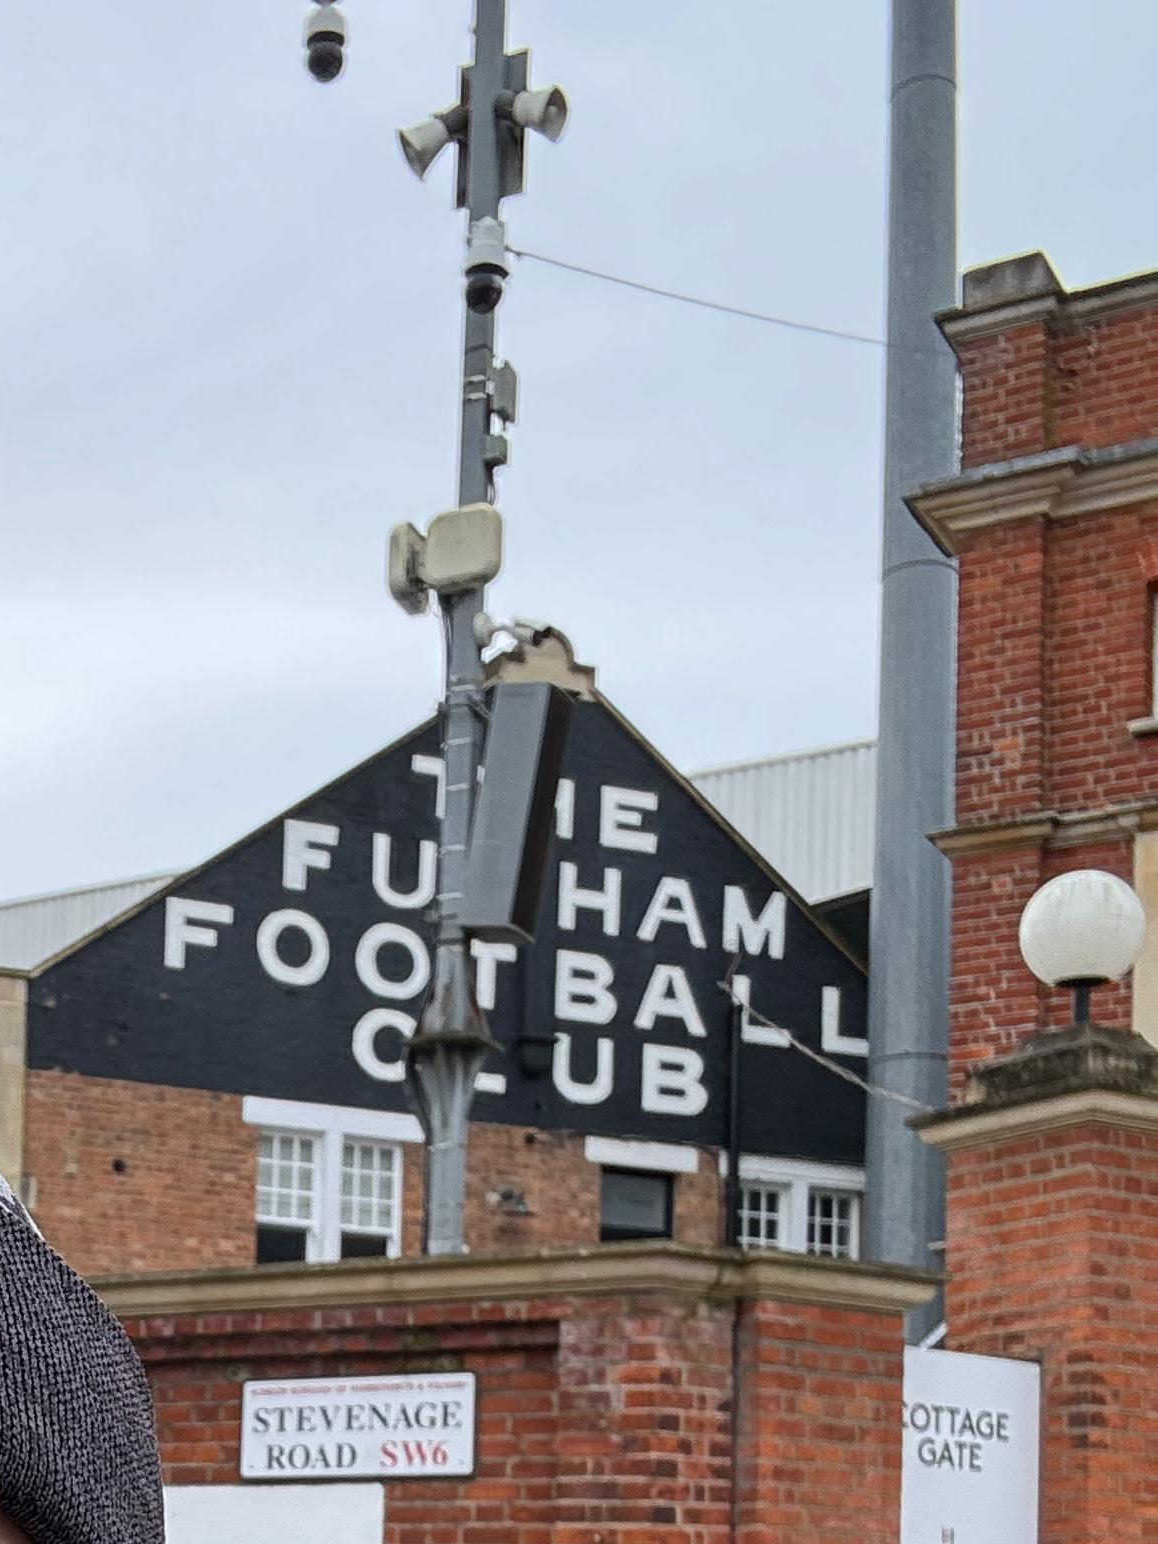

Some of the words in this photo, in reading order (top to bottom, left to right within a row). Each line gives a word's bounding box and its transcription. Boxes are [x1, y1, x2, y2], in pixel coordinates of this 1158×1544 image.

[282, 818, 787, 960] FUHAM
[163, 896, 869, 1057] FOOTBALL
[352, 1006, 709, 1117] CUB
[252, 1399, 463, 1435] STEVENAGE
[266, 1441, 358, 1470] ROAD
[378, 1439, 450, 1468] SW6
[918, 1437, 983, 1473] GATE
